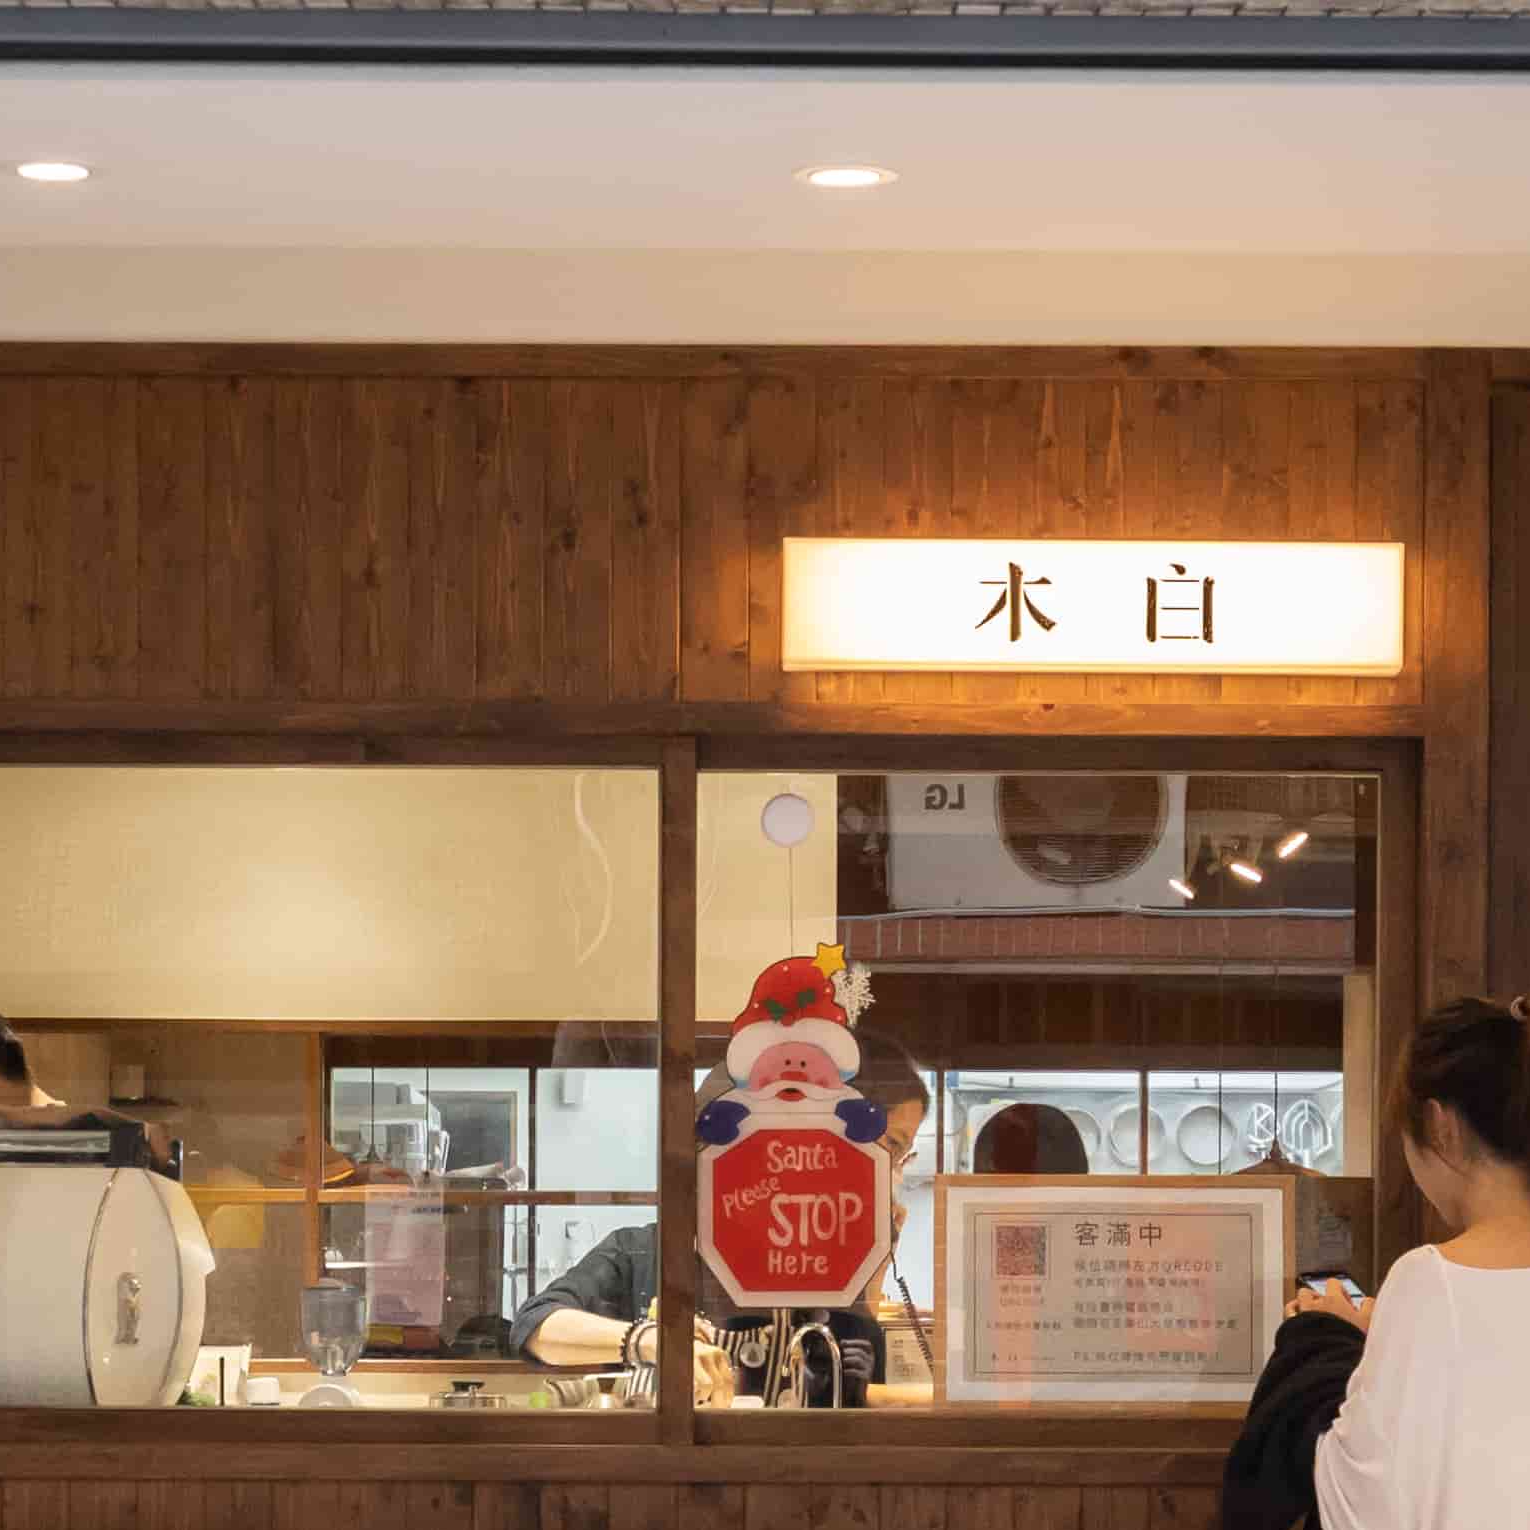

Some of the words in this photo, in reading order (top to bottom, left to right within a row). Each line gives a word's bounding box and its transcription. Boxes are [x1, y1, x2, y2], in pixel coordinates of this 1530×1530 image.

[975, 562, 1215, 643] 木白
[767, 1141, 838, 1172] Santa
[722, 1176, 781, 1218] Please
[767, 1191, 864, 1248] STOP
[1074, 1222, 1162, 1247] 客滿中
[767, 1250, 830, 1275] Here
